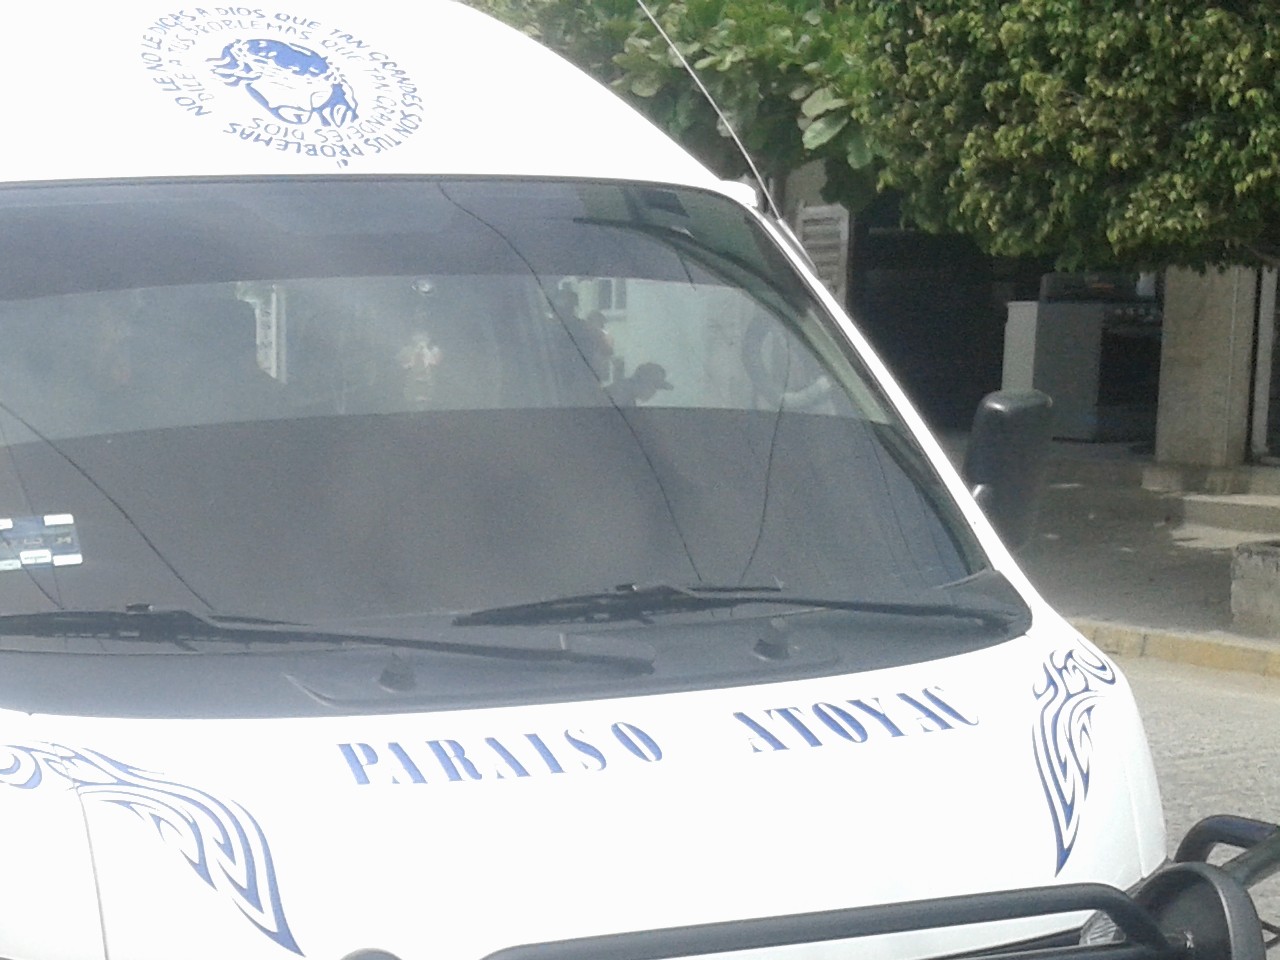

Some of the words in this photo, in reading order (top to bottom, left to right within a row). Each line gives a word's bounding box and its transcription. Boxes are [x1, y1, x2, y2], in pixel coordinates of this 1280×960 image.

[215, 7, 266, 18] DIOS
[274, 13, 321, 29] QUE
[141, 35, 163, 50] LE
[329, 29, 370, 48] TAN
[141, 52, 168, 72] NO
[153, 76, 182, 91] LE
[174, 96, 213, 116] NO
[248, 118, 306, 141] DIOS
[392, 109, 423, 138] SON
[223, 123, 365, 157] PROBLEMAS
[363, 133, 402, 154] TUS
[336, 721, 663, 785] PARAISO
[732, 686, 980, 753] ATOYAC
